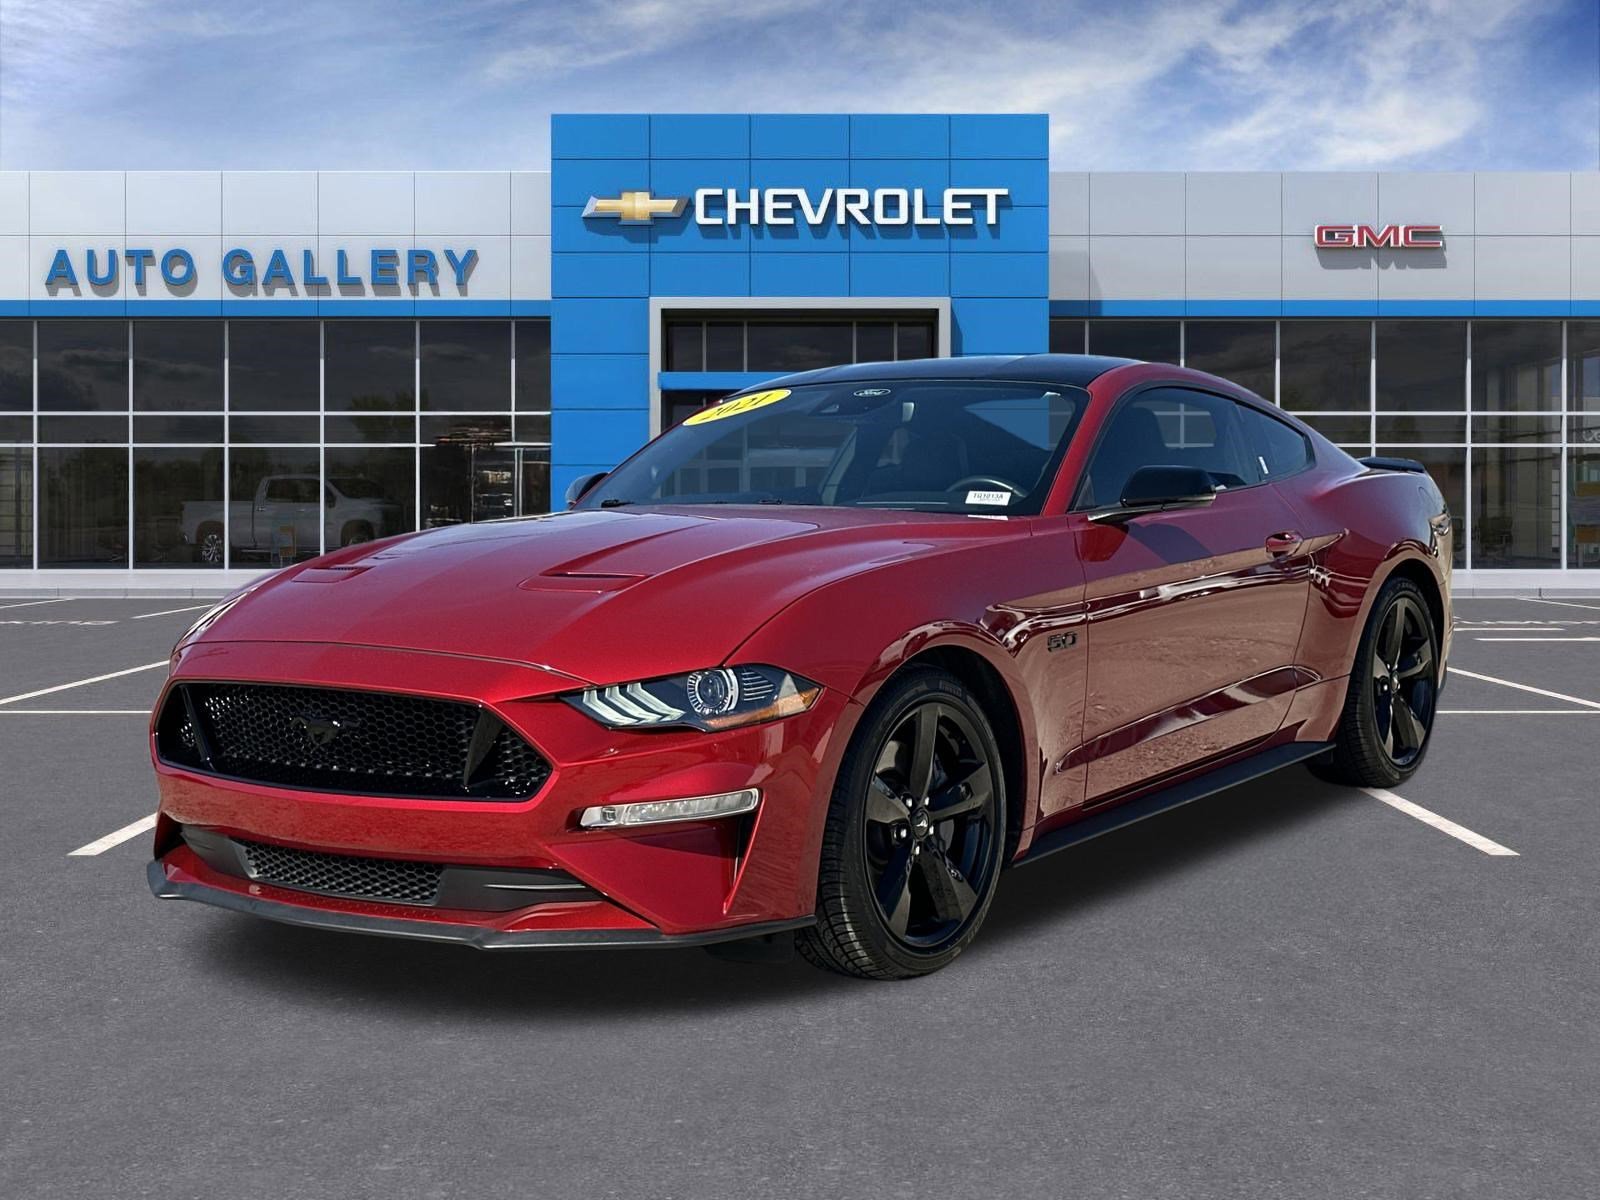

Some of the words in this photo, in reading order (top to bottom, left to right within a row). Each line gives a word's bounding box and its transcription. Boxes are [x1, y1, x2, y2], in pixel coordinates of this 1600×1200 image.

[694, 188, 1009, 226] CHEVROLET
[1314, 224, 1443, 248] GMC
[44, 248, 195, 287] AUTO
[221, 248, 477, 287] GALLERY
[699, 393, 773, 421] 2021
